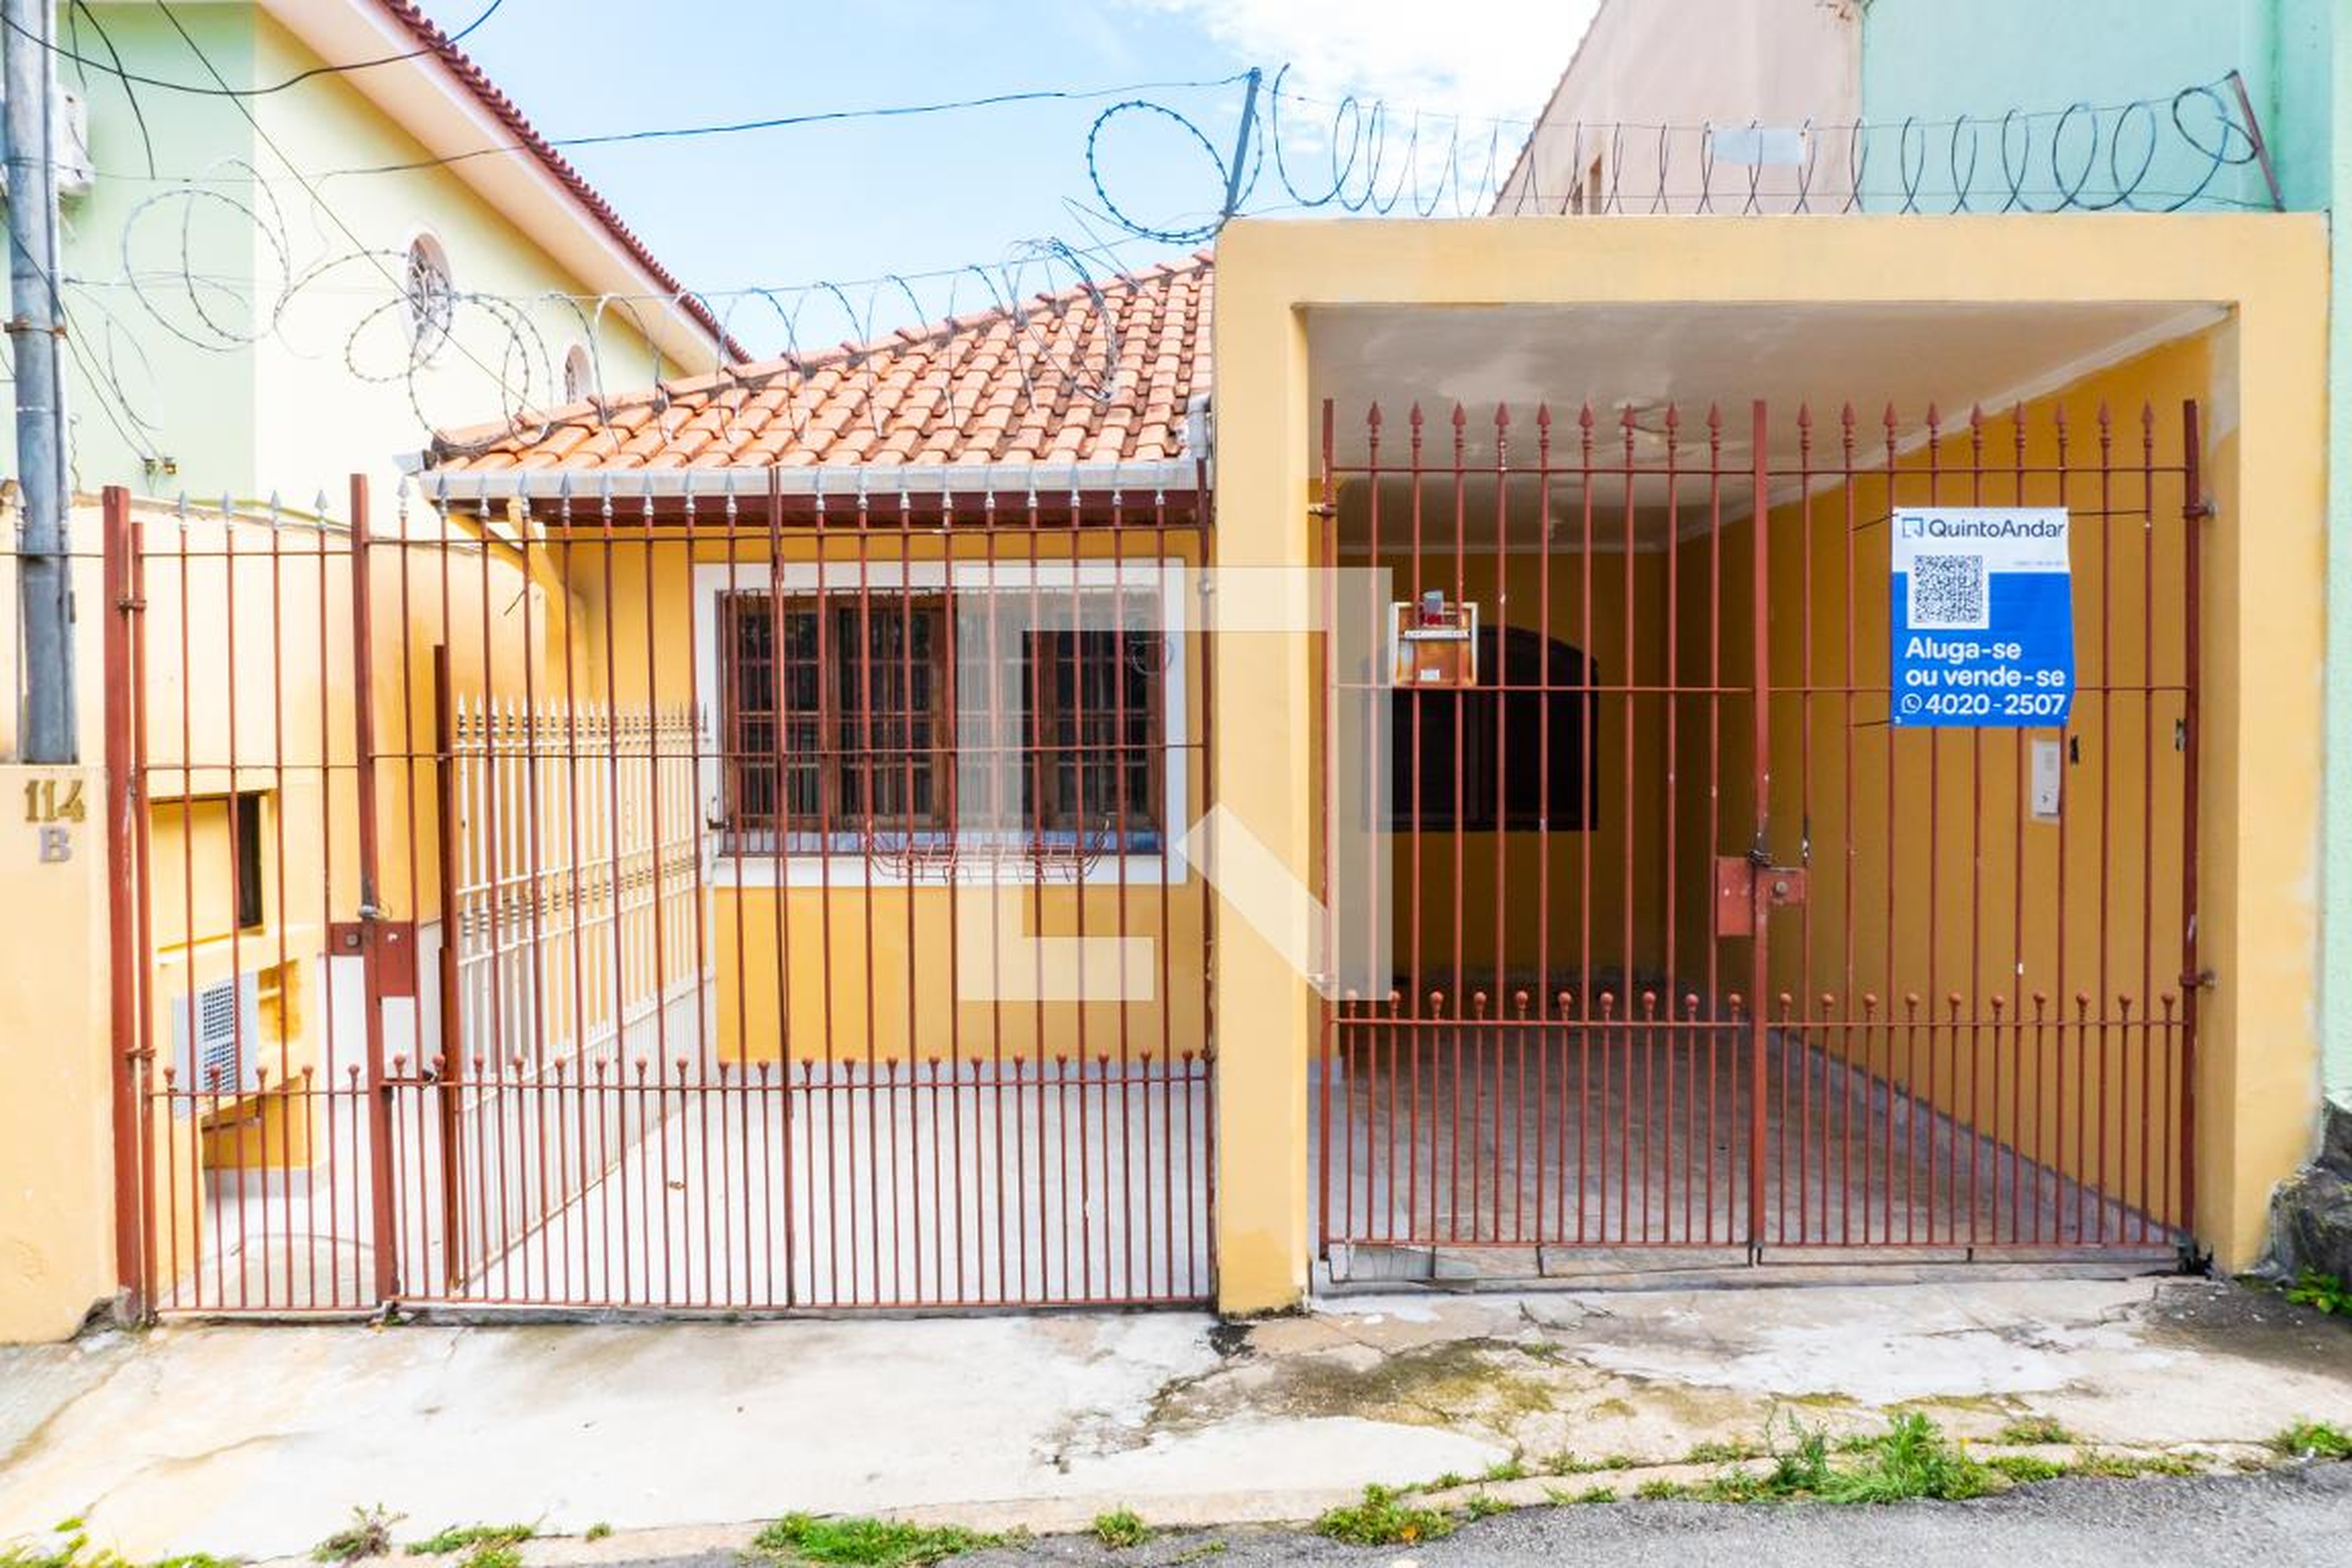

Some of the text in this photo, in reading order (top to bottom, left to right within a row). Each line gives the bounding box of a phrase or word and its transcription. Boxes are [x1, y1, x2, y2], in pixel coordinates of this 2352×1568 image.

[1929, 519, 2065, 538] QuintoAndar
[1905, 637, 2022, 664] Aluga-se
[1905, 665, 2065, 687] ou vende-se
[1925, 693, 2066, 715] 4020-2507
[24, 779, 86, 823] 114
[40, 827, 72, 863] B
